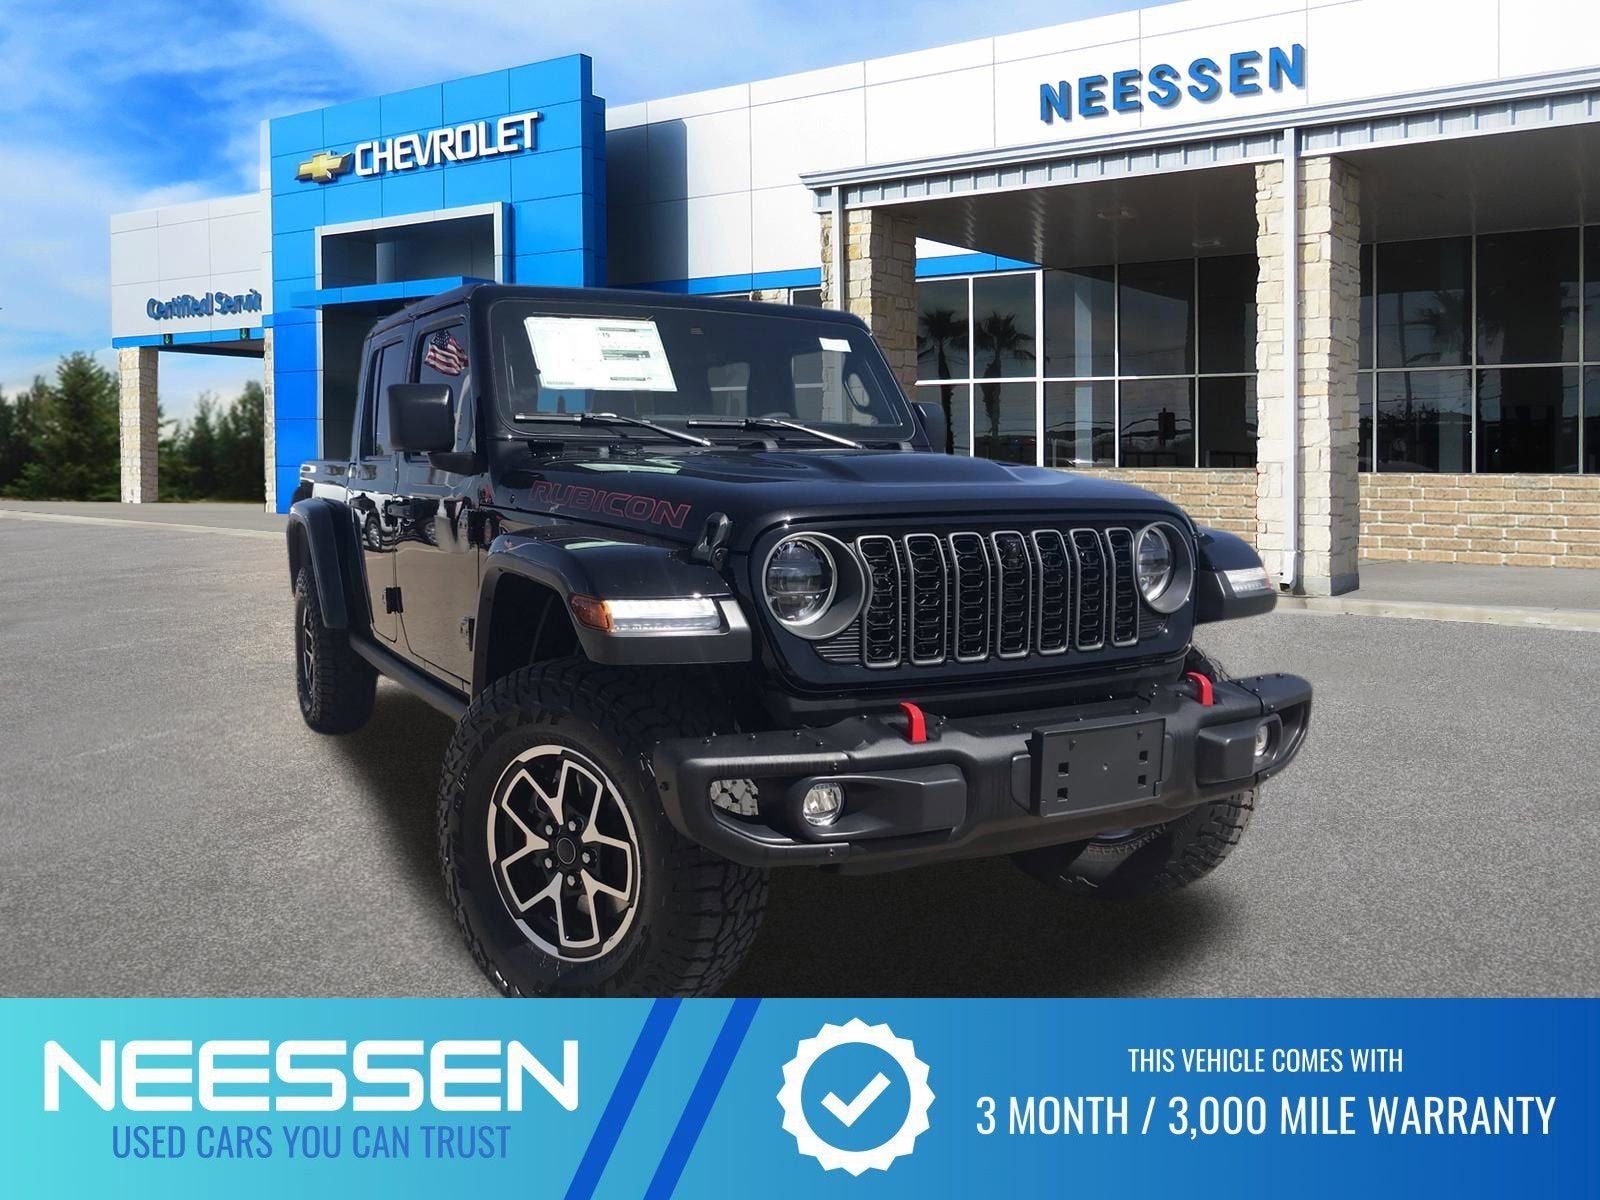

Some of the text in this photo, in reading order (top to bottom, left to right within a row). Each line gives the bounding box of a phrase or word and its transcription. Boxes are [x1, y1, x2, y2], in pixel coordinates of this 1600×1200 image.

[1040, 44, 1305, 123] NEESSEN
[355, 111, 540, 177] CHEVROLET
[147, 292, 213, 320] Certified
[529, 480, 692, 529] RUBICON
